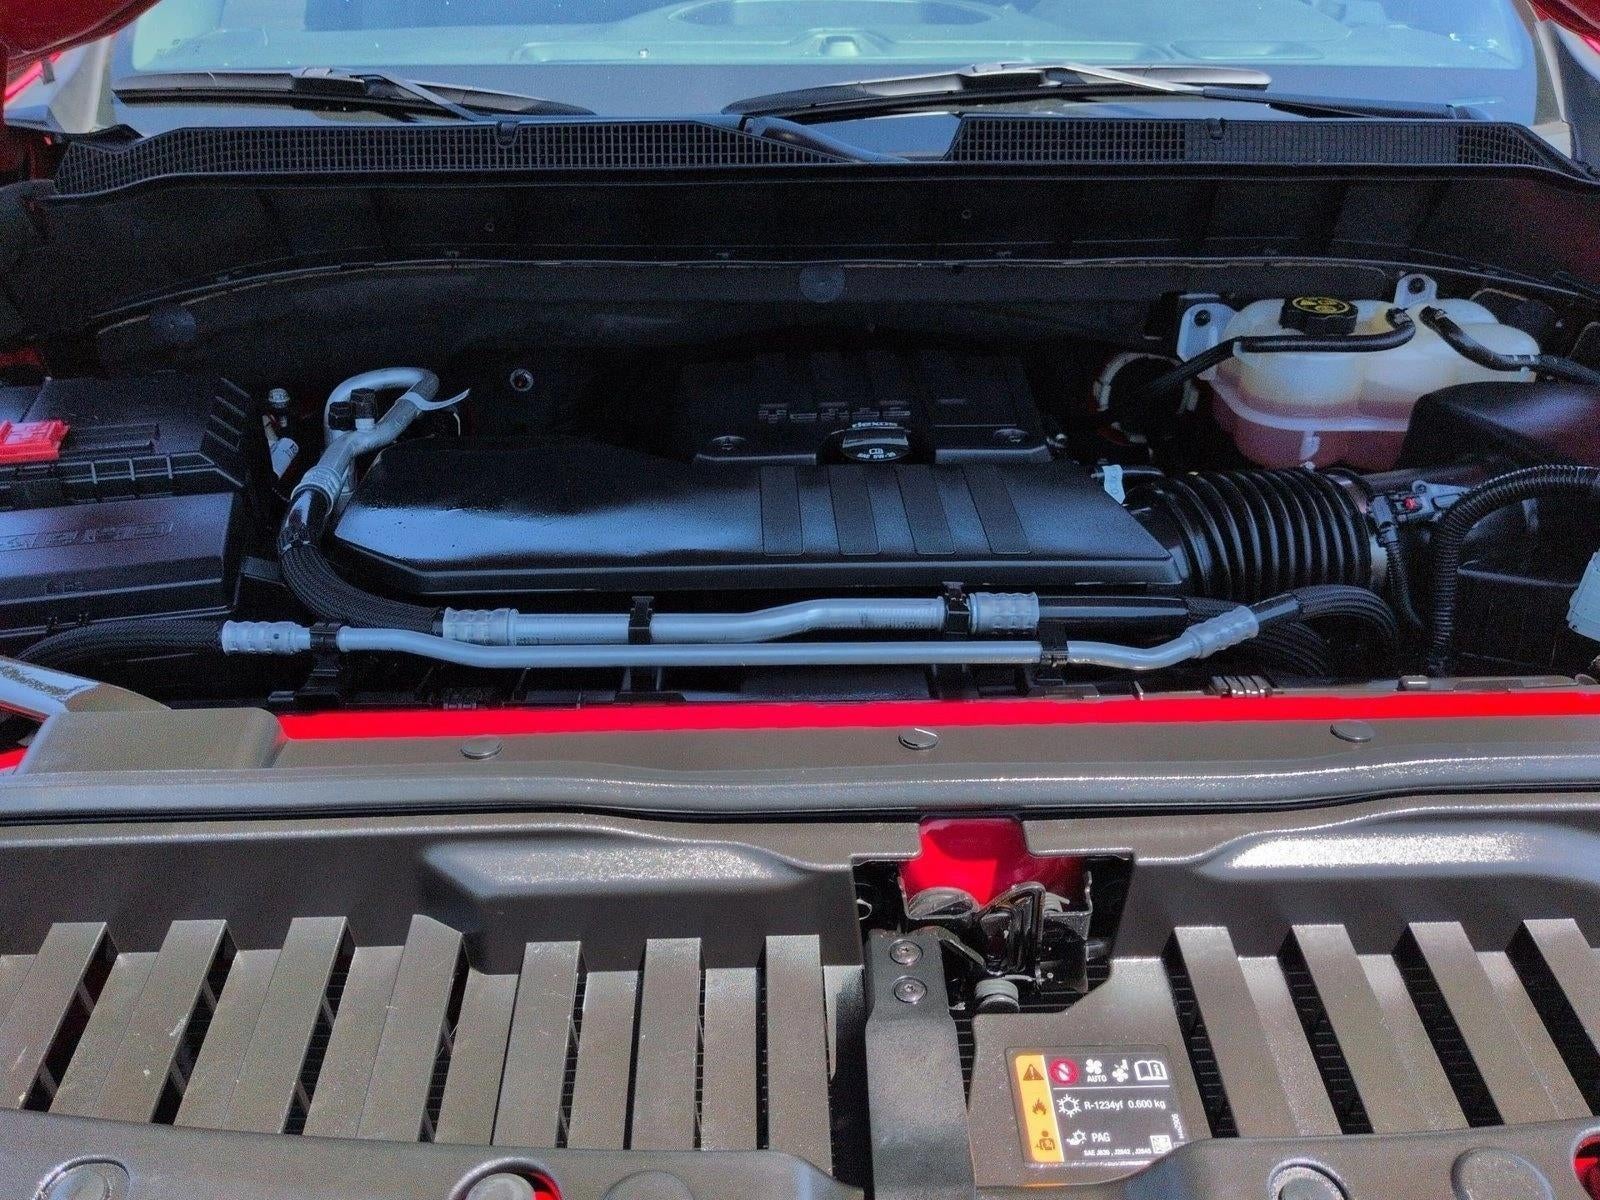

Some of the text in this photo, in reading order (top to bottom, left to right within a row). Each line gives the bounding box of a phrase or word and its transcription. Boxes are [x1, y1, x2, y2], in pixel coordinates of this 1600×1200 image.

[1087, 1074, 1107, 1083] AUTO
[1084, 1099, 1166, 1111] R-1234yf 0.600 kg
[1091, 1132, 1111, 1143] PAG
[1083, 1149, 1095, 1157] SAE
